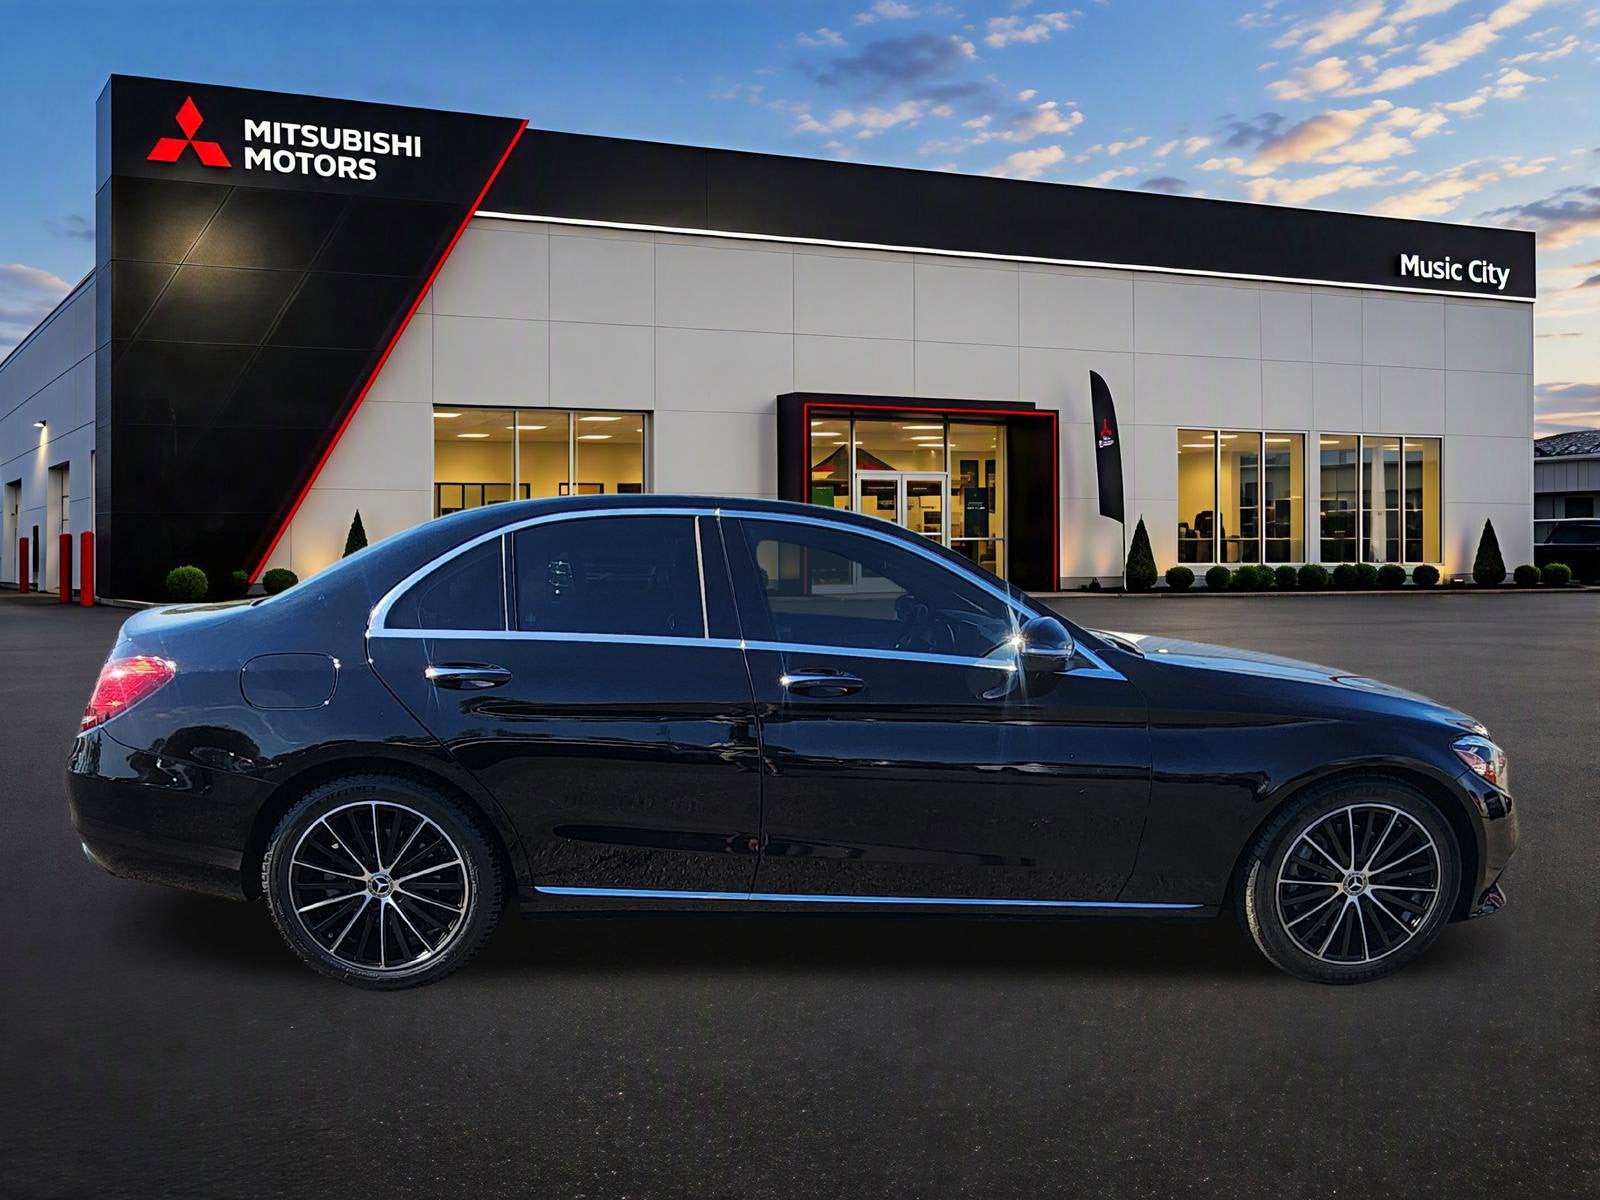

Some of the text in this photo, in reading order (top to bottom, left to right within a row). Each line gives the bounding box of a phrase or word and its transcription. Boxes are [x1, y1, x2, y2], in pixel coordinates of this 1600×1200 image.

[244, 118, 422, 158] MITSUBISHI
[244, 146, 377, 181] MOTORS
[1400, 253, 1511, 290] Music City
